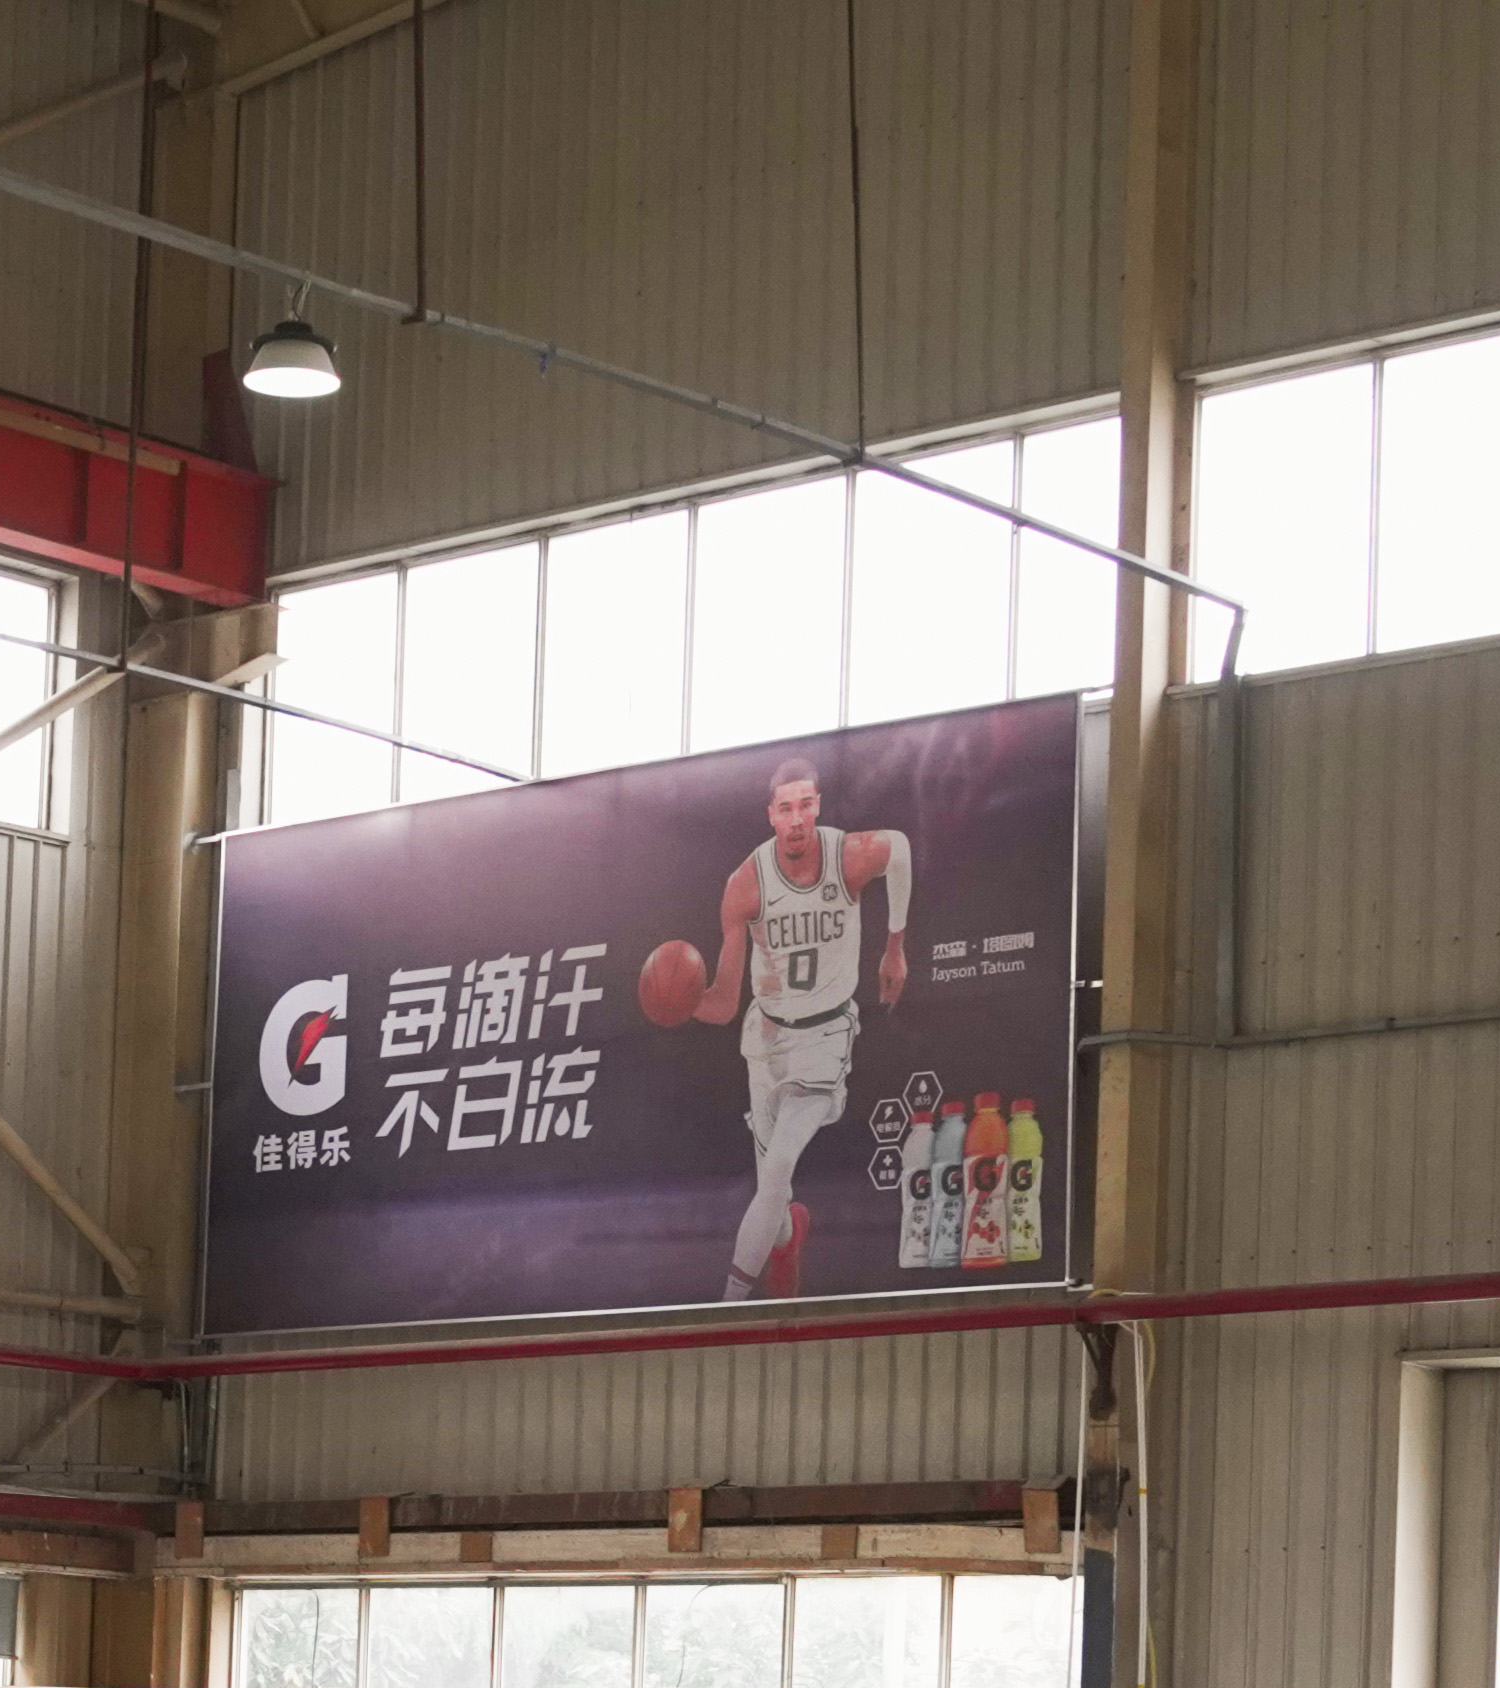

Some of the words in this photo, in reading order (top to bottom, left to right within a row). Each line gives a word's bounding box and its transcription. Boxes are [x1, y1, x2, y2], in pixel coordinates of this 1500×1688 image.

[767, 910, 845, 949] CELTICS
[788, 948, 818, 991] 0
[932, 964, 977, 982] Jayson
[980, 958, 1026, 974] Tatum
[380, 944, 607, 1058] 每滴汗
[259, 974, 348, 1116] G
[375, 1046, 601, 1158] 不白流
[253, 1126, 351, 1173] 佳得乐
